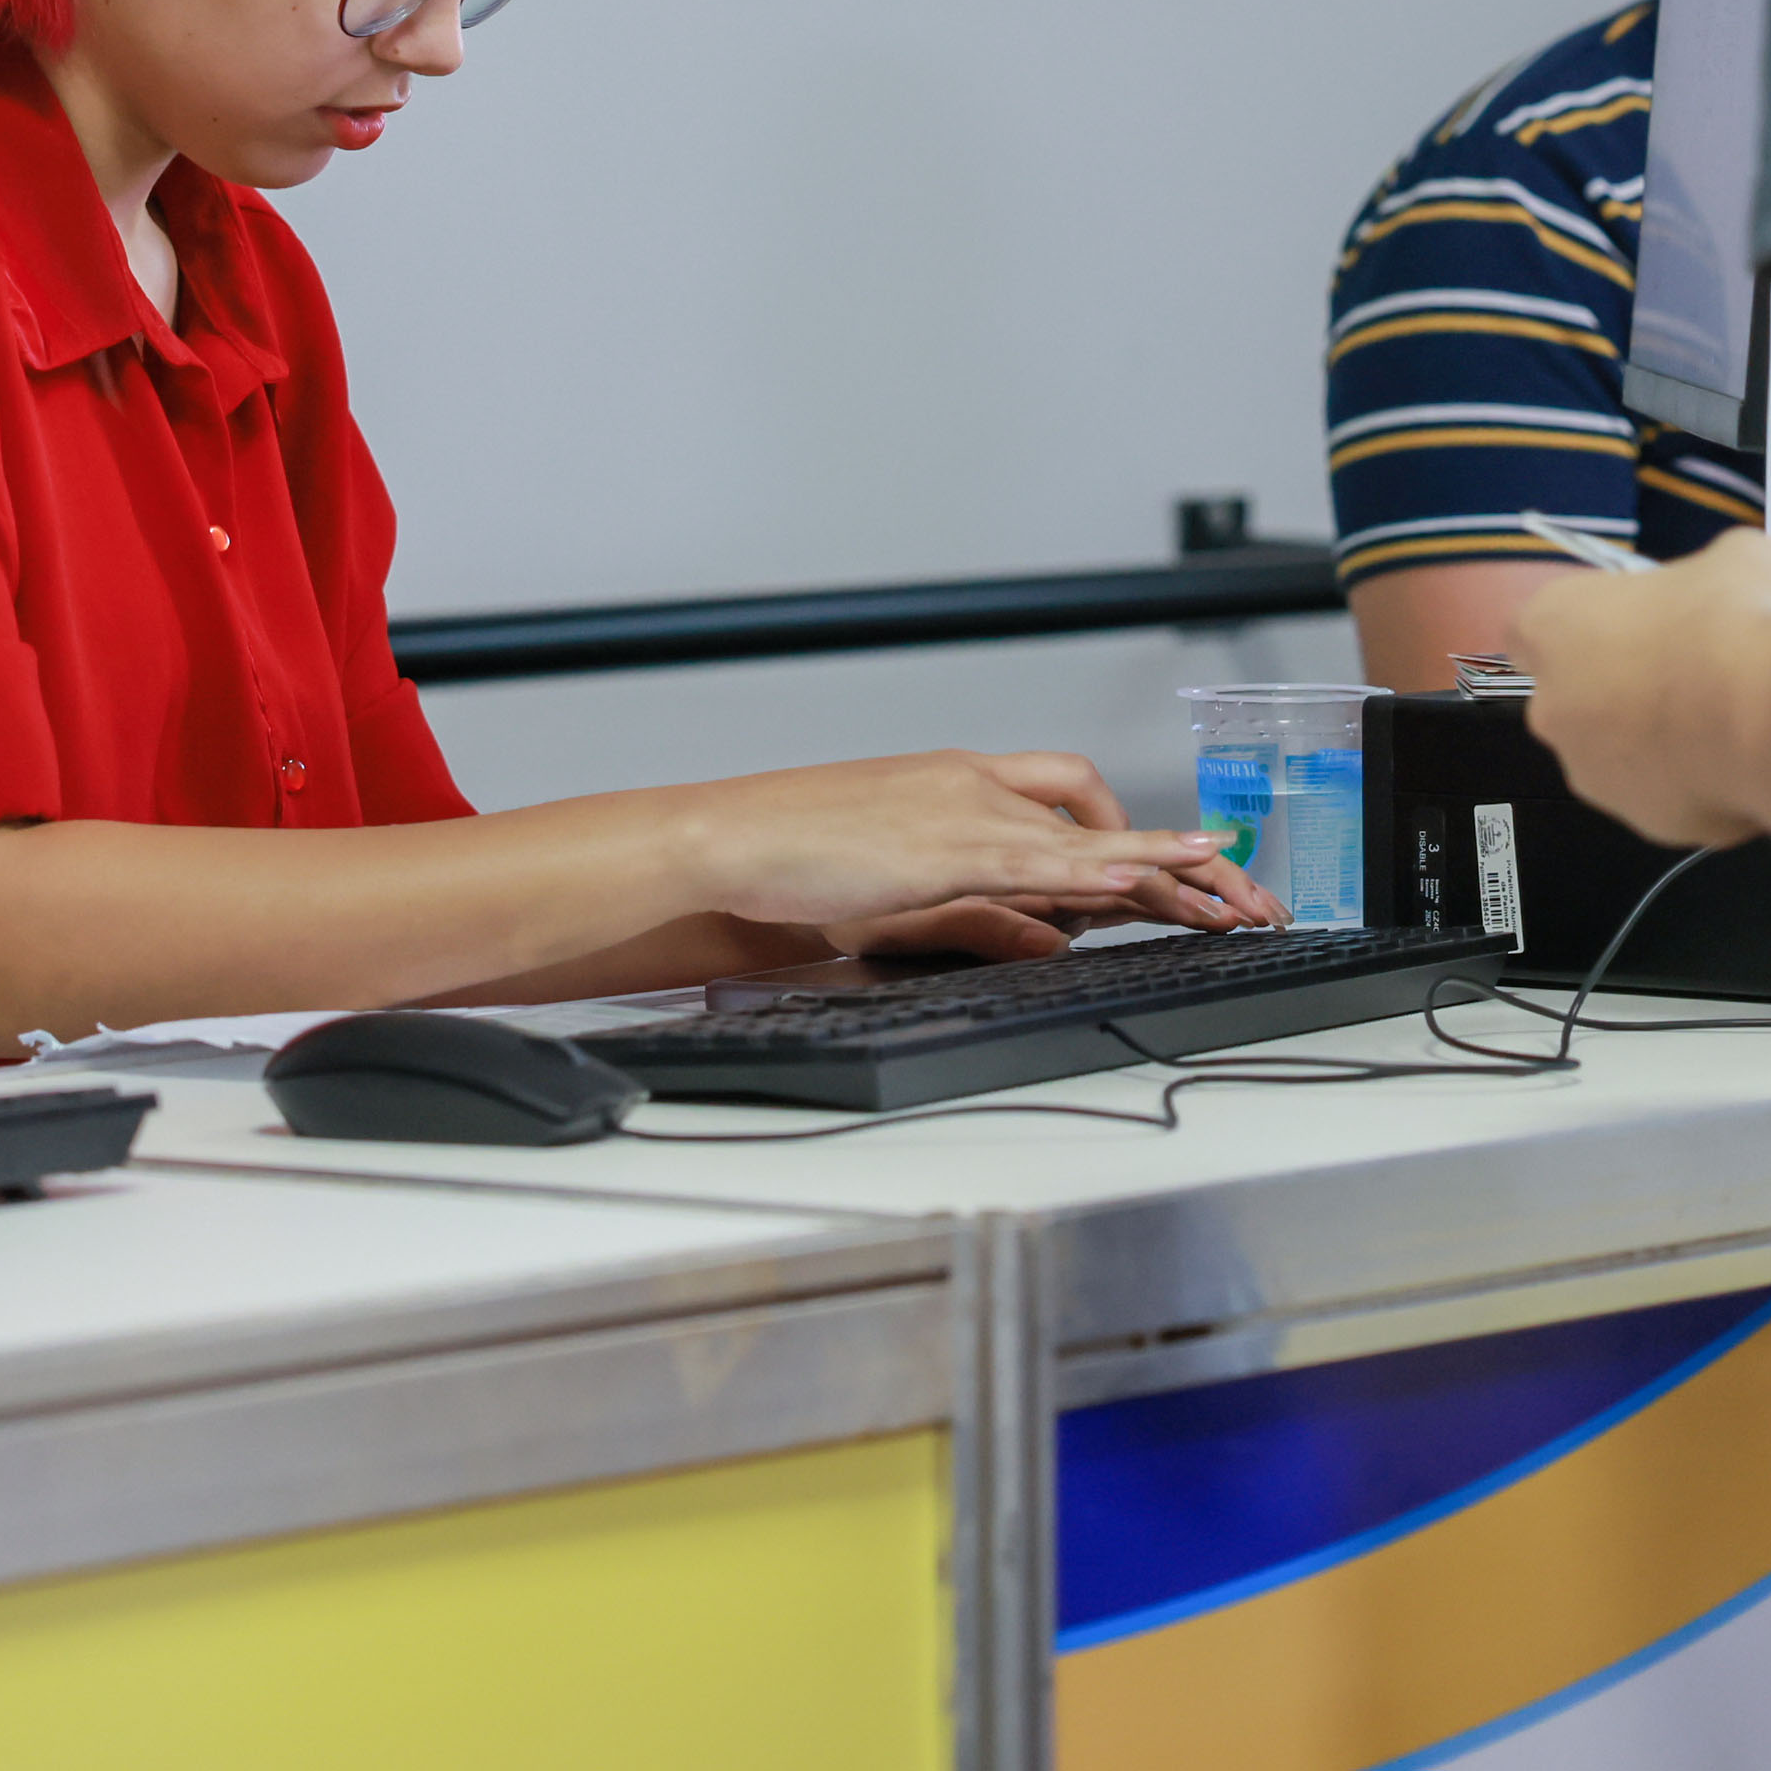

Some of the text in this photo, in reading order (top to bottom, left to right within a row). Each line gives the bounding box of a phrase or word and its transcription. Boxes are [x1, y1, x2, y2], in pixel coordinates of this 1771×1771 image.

[1419, 830, 1427, 872] DISABLE
[1428, 843, 1440, 853] 3
[1506, 859, 1515, 904] Prefeitura
